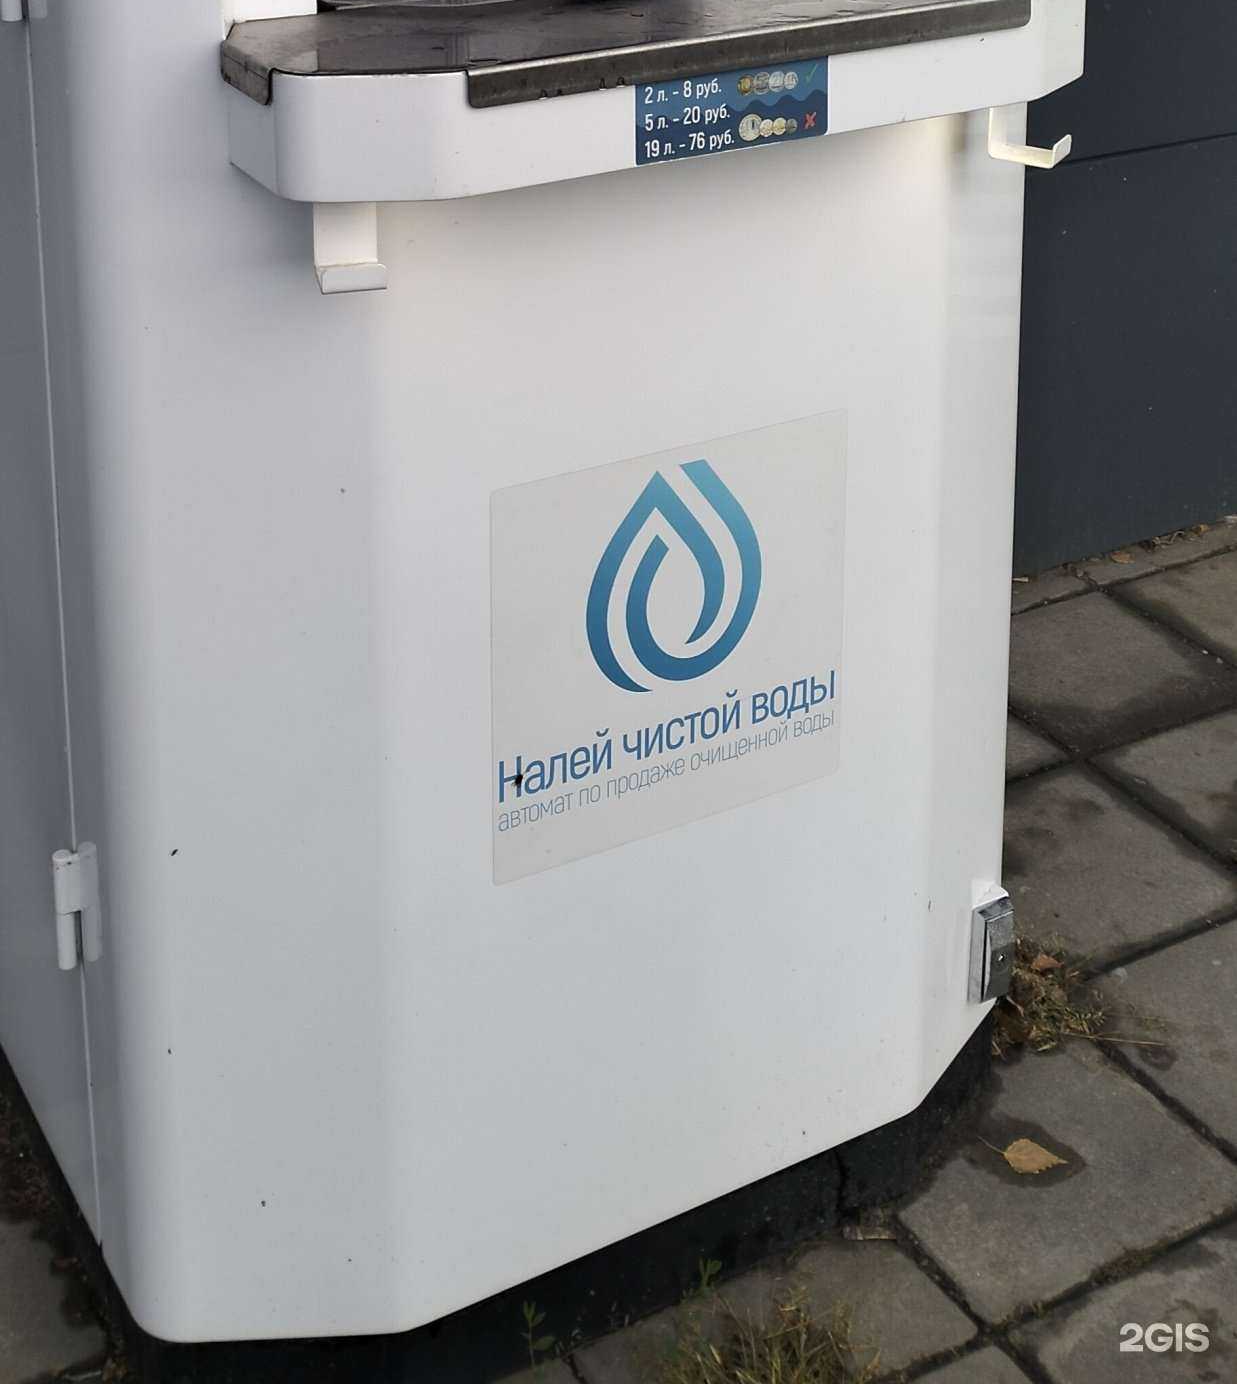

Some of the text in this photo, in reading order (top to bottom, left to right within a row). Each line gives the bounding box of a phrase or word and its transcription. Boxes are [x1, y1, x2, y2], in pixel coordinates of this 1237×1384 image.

[645, 87, 653, 104] 2
[657, 89, 668, 102] л.
[683, 80, 692, 98] 8
[696, 78, 722, 100] руб.
[645, 113, 653, 131] 5
[657, 115, 669, 129] л.
[683, 106, 701, 125] 20
[705, 104, 730, 125] руб.
[645, 140, 659, 158] 19
[664, 141, 675, 155] л.
[689, 132, 705, 150] 76
[709, 129, 735, 149] руб.
[498, 670, 835, 803] Налей чистой воды
[498, 710, 834, 832] автомат по продаже очищенной воды
